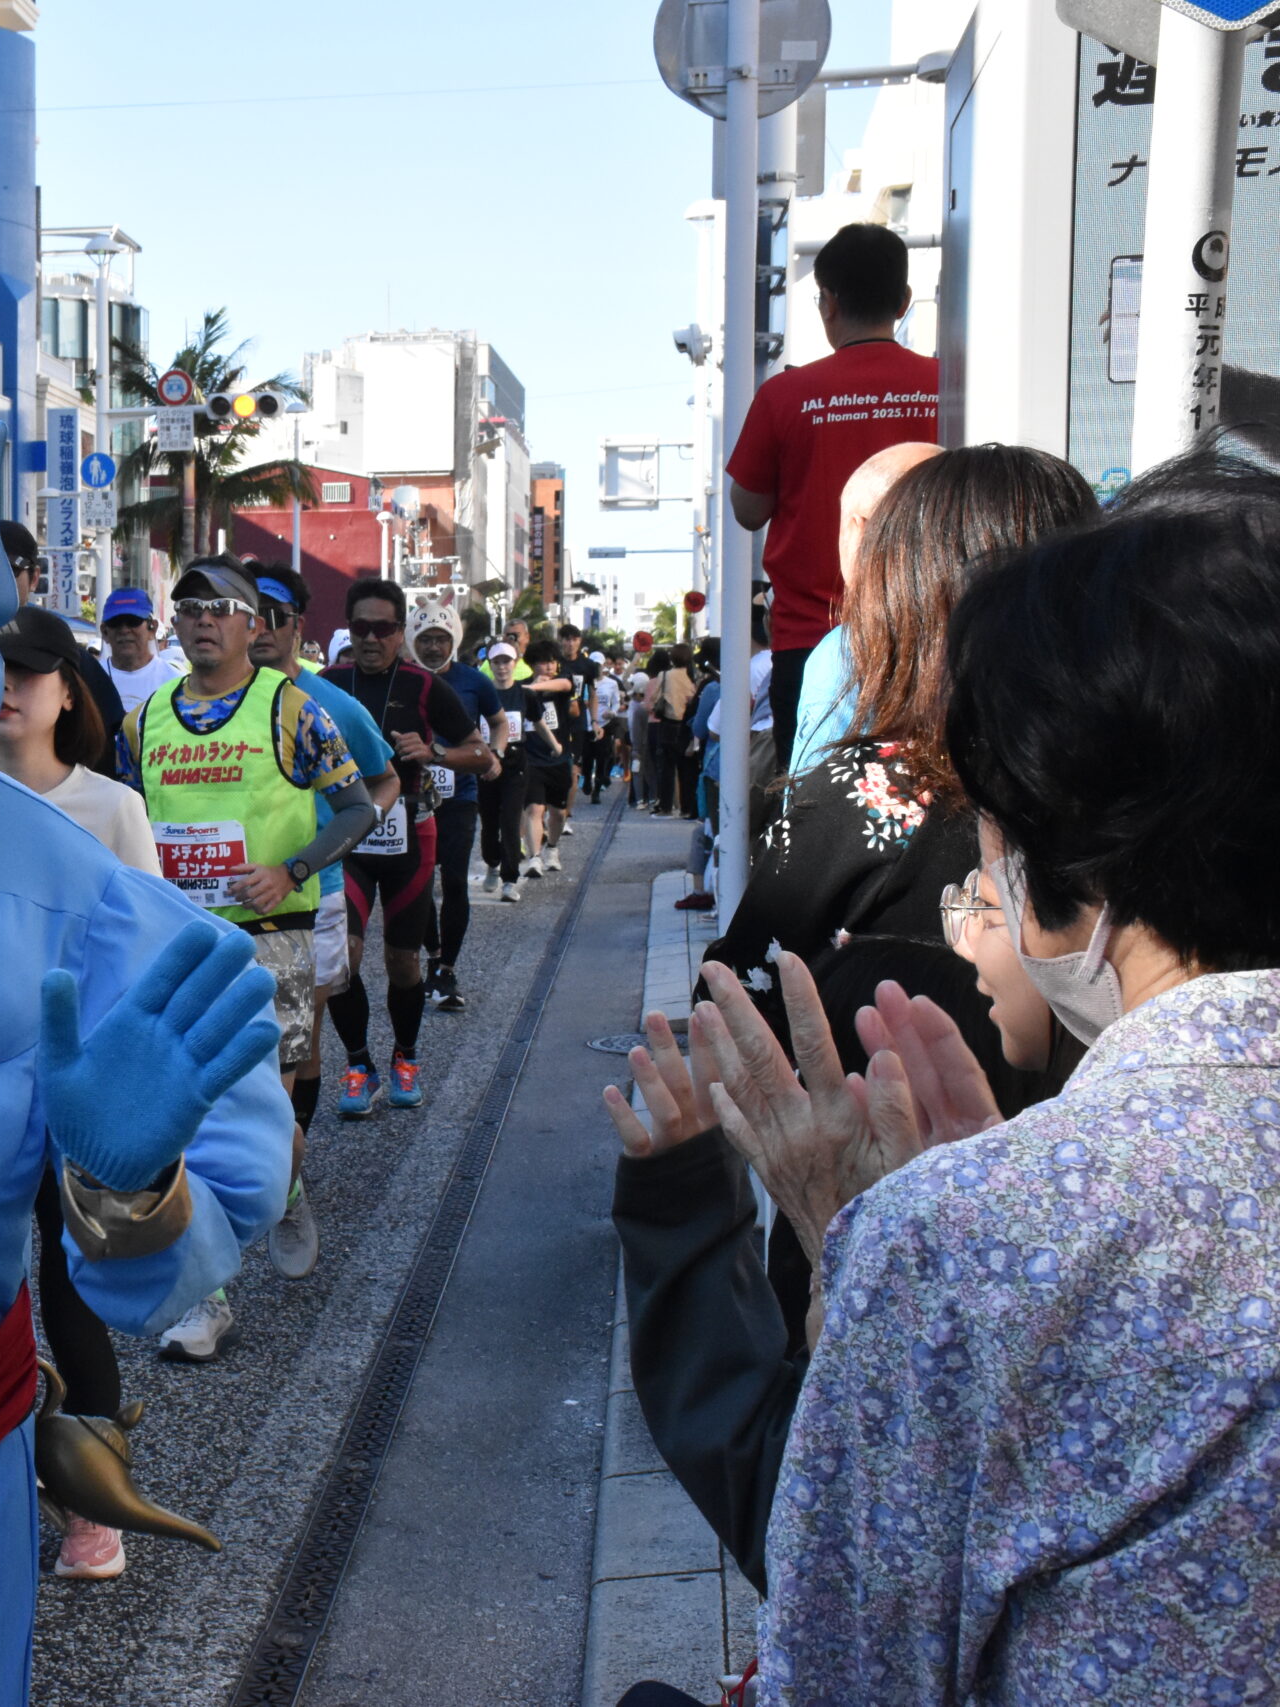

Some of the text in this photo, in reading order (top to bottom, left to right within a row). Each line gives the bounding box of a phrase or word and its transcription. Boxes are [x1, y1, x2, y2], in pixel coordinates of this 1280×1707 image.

[801, 390, 939, 413] JAL Athlete Academ
[813, 408, 935, 425] in Itoman 2025.11.16
[148, 740, 264, 767] メディカルランナー
[160, 766, 244, 786] NAHAマラソン
[186, 826, 219, 835] SPORTS
[171, 843, 232, 860] メディカル
[177, 862, 227, 876] ランナー
